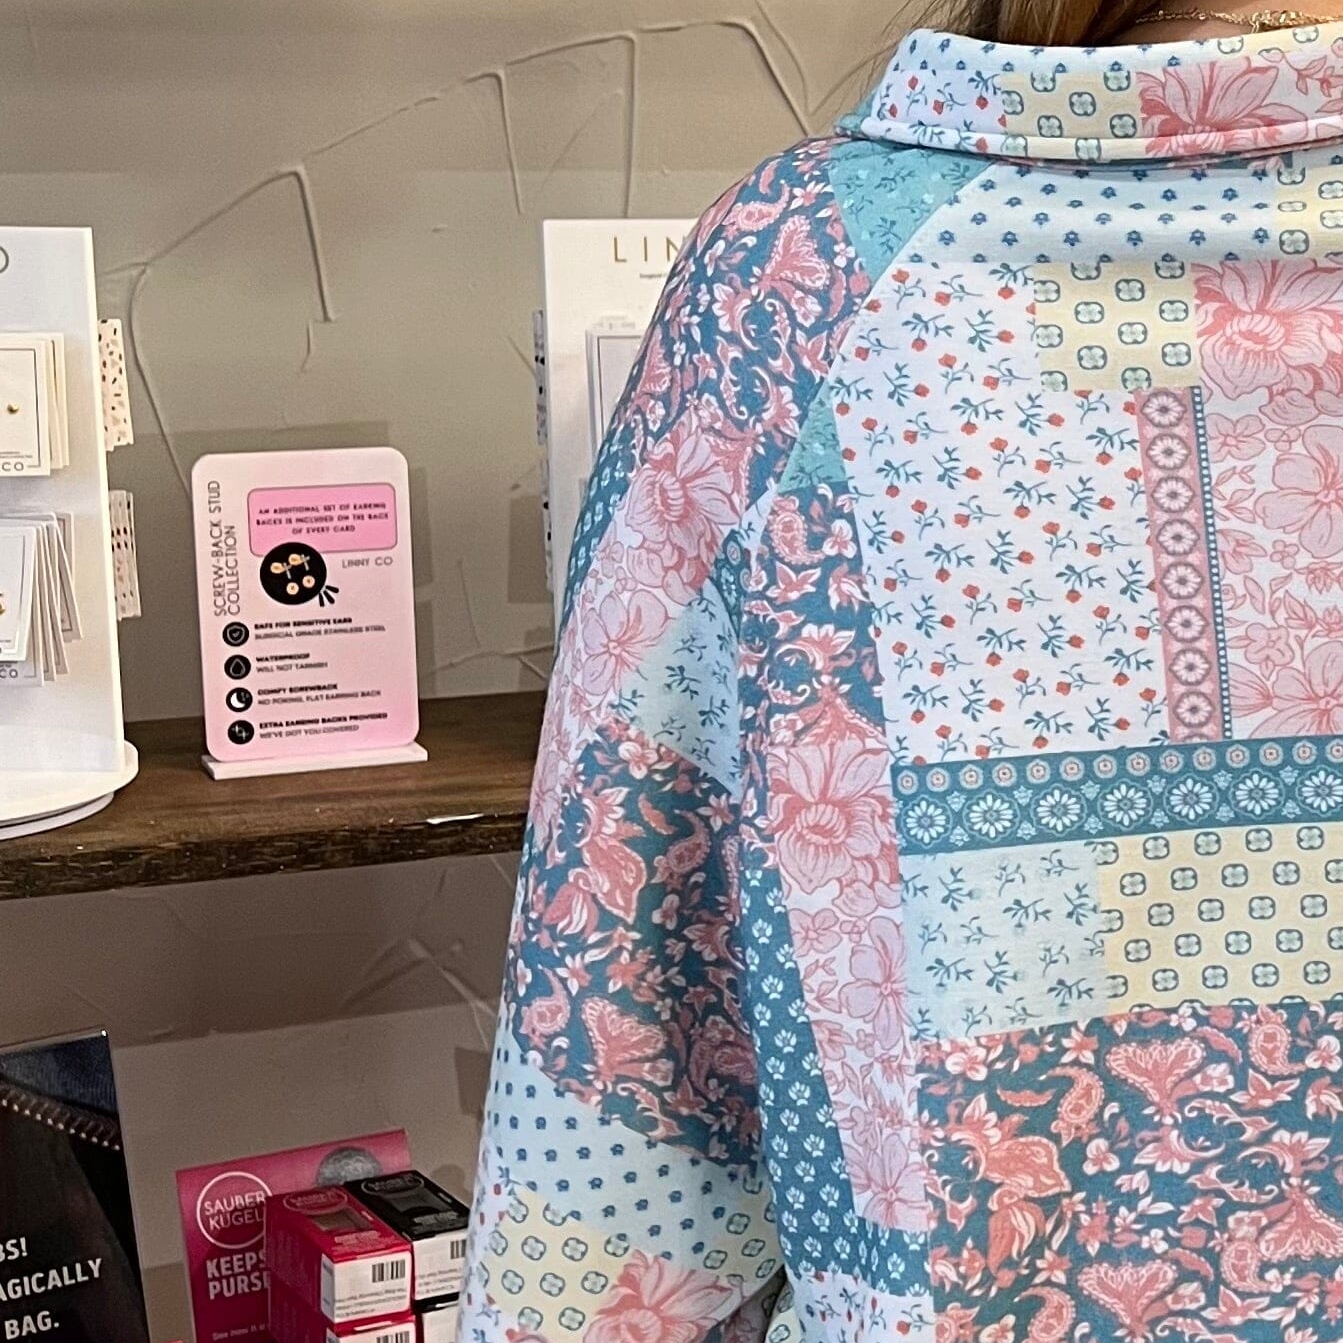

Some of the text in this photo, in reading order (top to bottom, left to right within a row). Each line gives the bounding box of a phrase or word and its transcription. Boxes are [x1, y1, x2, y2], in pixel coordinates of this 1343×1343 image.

[207, 480, 227, 617] SCREW-BACK STUD
[374, 556, 393, 566] CO
[223, 525, 241, 617] COLLECTION
[204, 1190, 266, 1216] SAUBER
[209, 1208, 264, 1232] KUGEL
[4, 1310, 60, 1341] BAG.
